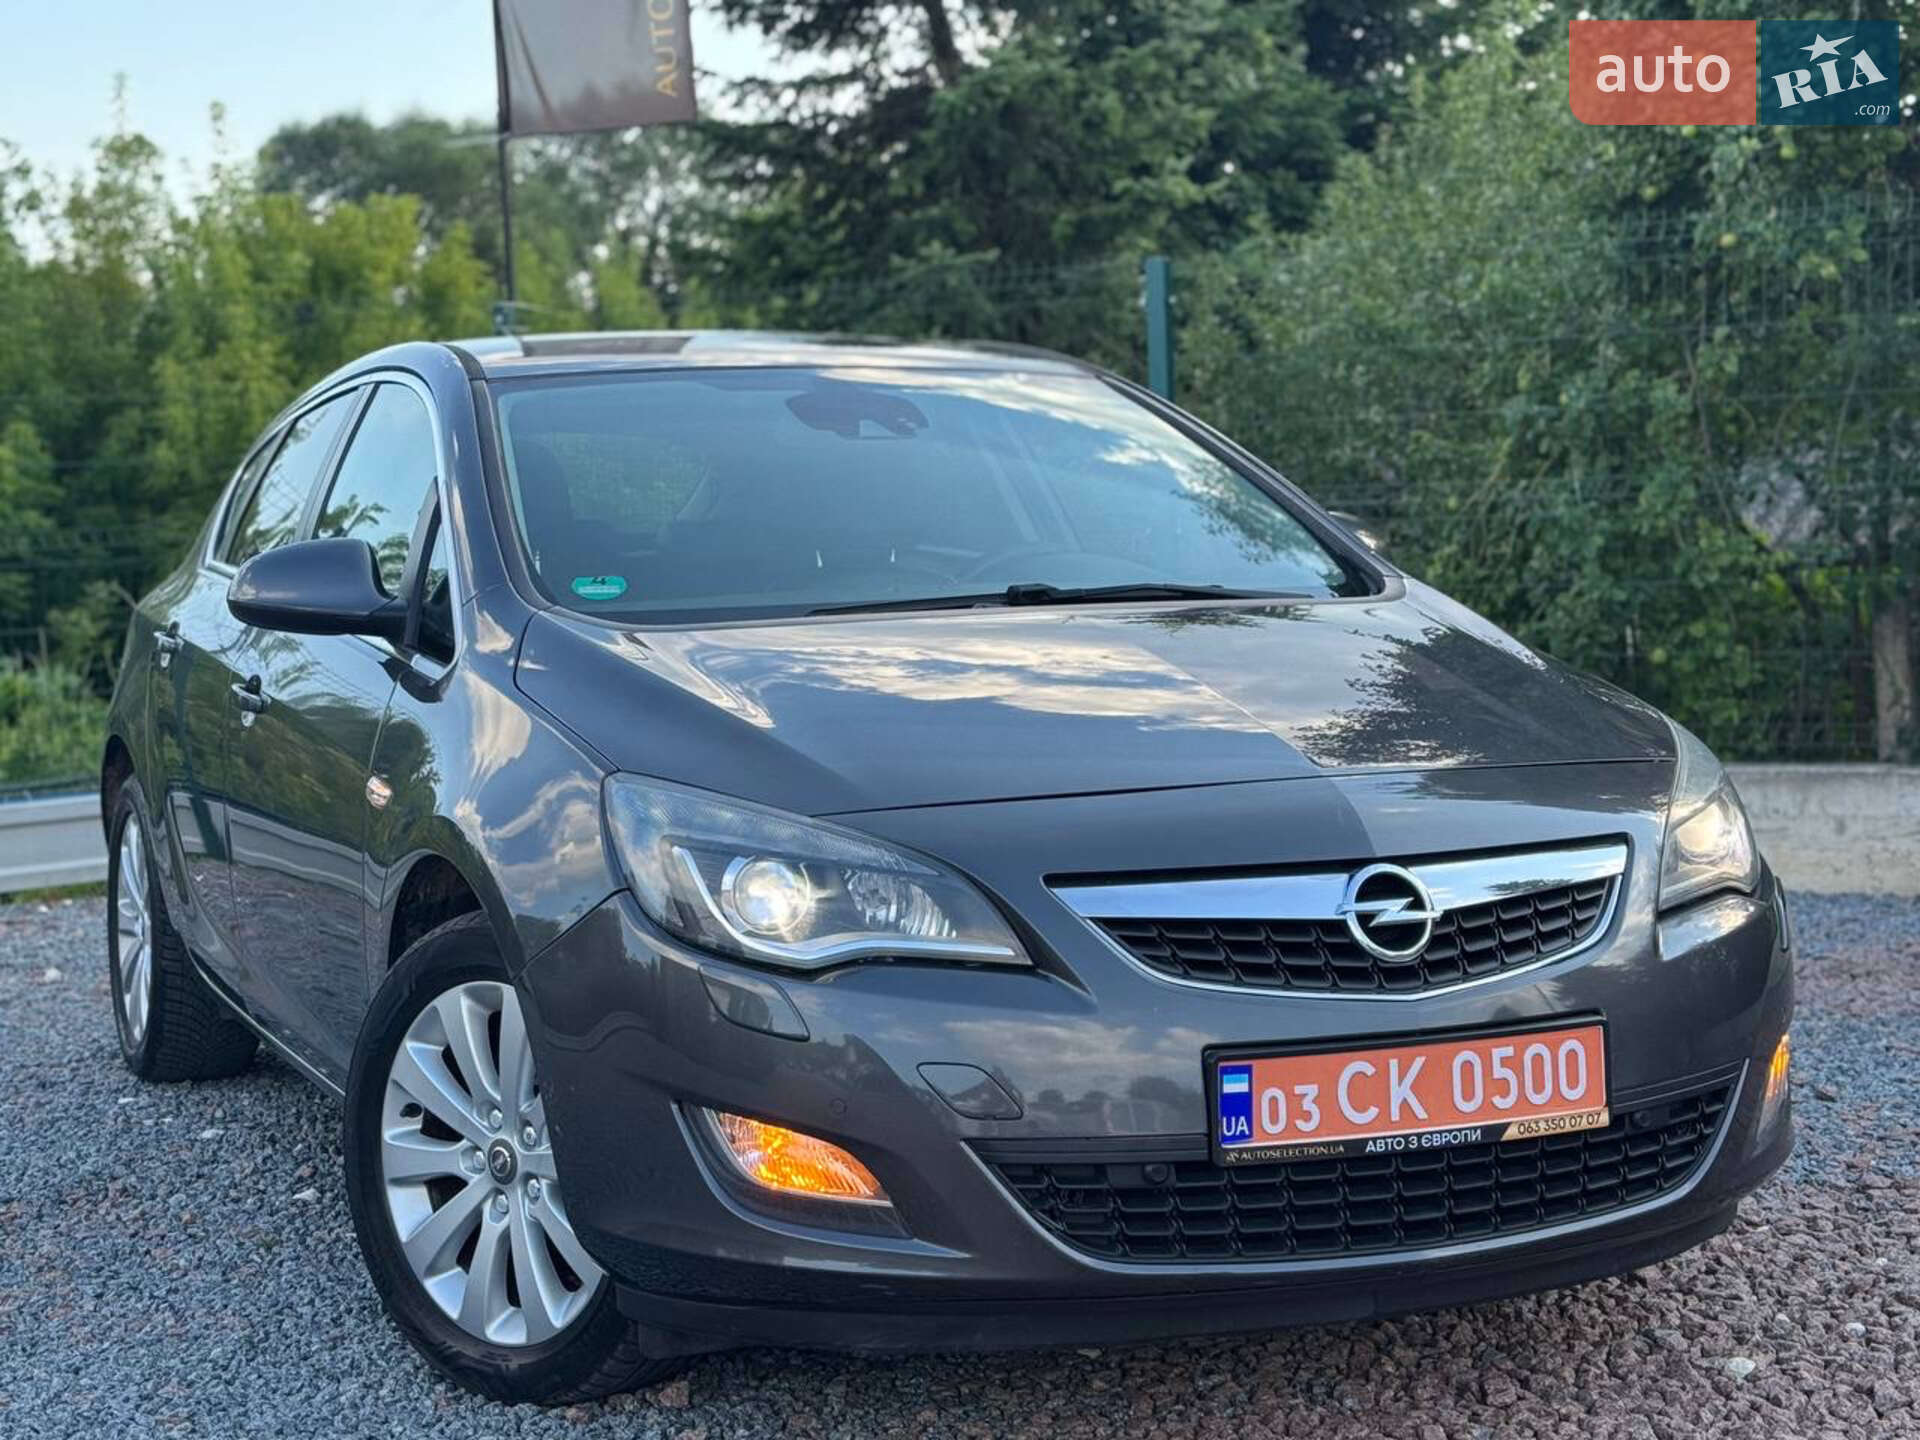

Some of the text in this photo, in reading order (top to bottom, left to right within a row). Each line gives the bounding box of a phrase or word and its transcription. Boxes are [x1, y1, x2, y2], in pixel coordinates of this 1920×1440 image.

[1260, 1038, 1588, 1135] 03 CK 0500
[1222, 1115, 1250, 1137] UA
[1517, 1112, 1601, 1136] 063 350 07 07
[1240, 1143, 1345, 1161] AUTOSELECTION.UA
[1365, 1137, 1405, 1153] АВТО
[1421, 1128, 1482, 1148] ЄВРОПИ
